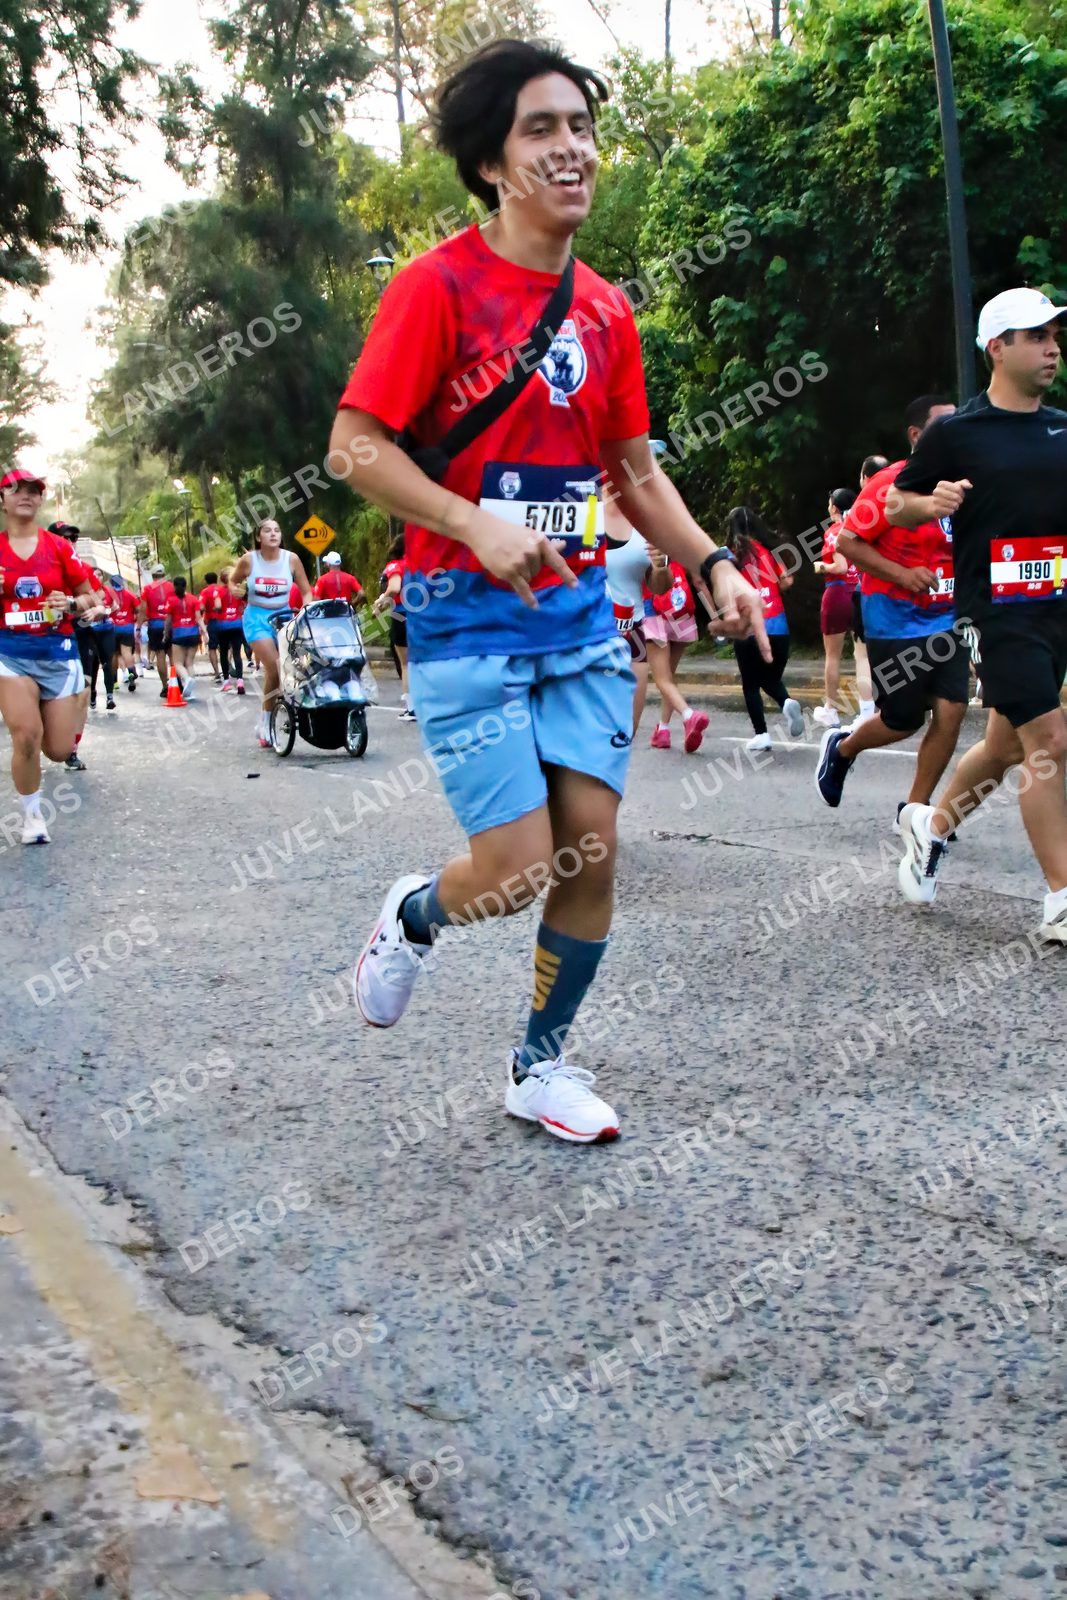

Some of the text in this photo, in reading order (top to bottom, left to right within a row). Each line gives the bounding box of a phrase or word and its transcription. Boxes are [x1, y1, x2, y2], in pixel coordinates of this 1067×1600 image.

[525, 504, 577, 533] 5703
[1019, 561, 1050, 580] 1990
[24, 611, 44, 623] 1441
